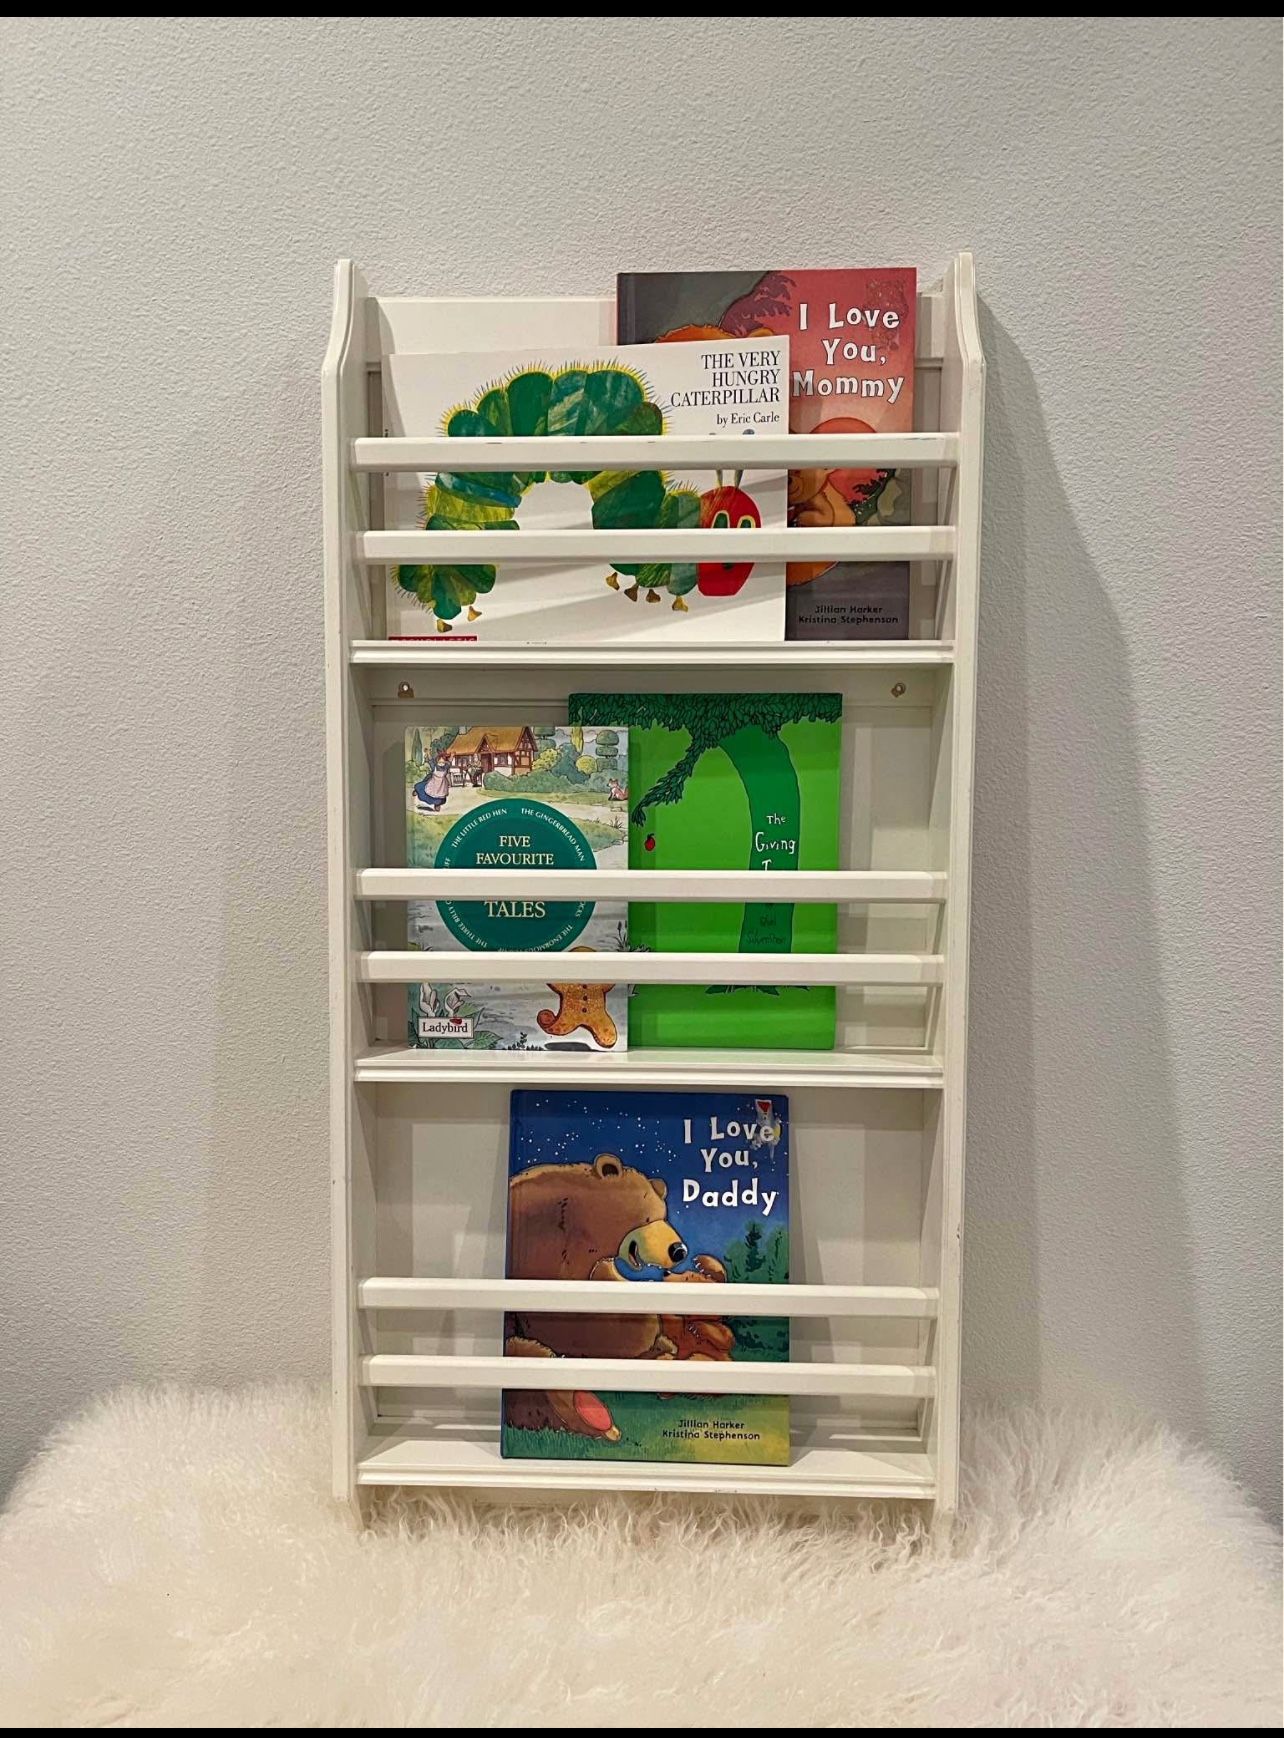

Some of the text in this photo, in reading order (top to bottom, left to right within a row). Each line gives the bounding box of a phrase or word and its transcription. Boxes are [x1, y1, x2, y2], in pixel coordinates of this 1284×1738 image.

[799, 302, 900, 331] I Love
[701, 350, 781, 370] THE VERY
[821, 338, 887, 366] You,
[712, 368, 781, 388] HUNGRY
[792, 369, 905, 404] Mommy
[670, 387, 780, 408] CATERPILLAR
[716, 411, 780, 428] by Eric Carle
[814, 604, 883, 614] Jillian Harker
[798, 615, 899, 626] Kristina Stephenson
[451, 808, 508, 848] THE LITTLE RED HEN
[766, 812, 787, 825] The
[499, 835, 530, 847] FIVE
[521, 808, 585, 861] THE GINGERBREAD MAN
[755, 831, 796, 855] Giving
[476, 852, 554, 865] FAVOURITE
[484, 901, 546, 918] TALES
[423, 1022, 468, 1034] Ladybird
[684, 1116, 775, 1144] I Love
[700, 1148, 758, 1172] You,
[683, 1177, 777, 1216] Daddy
[678, 1419, 745, 1429] Jillian Harker
[662, 1429, 760, 1441] Kristina Stephenson
